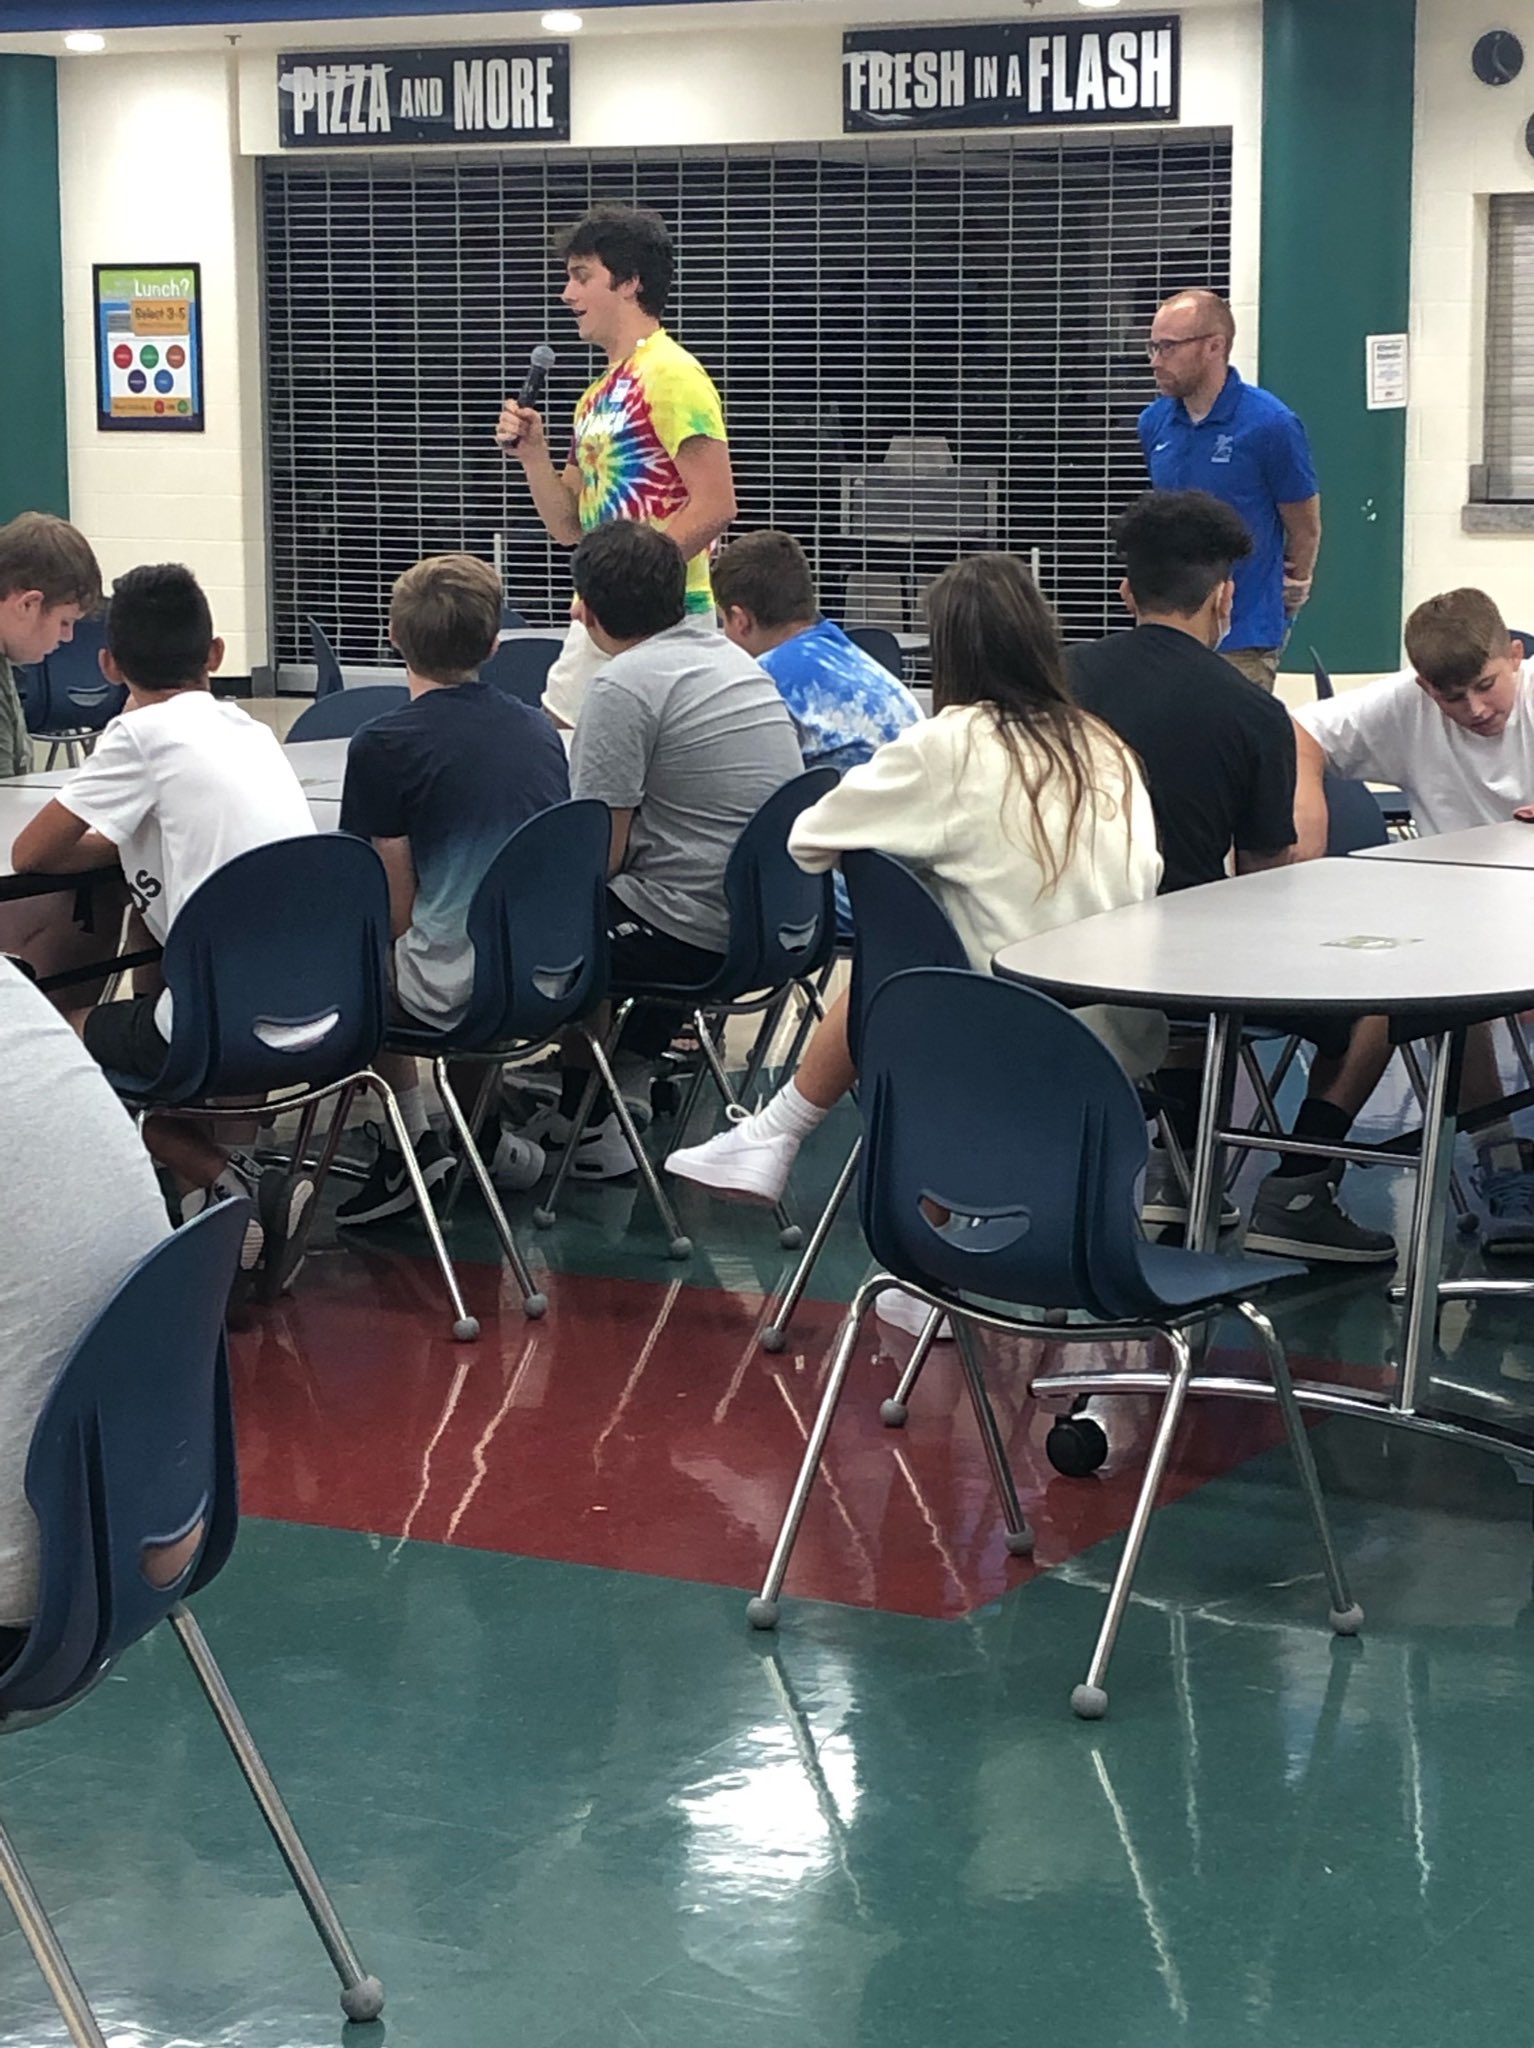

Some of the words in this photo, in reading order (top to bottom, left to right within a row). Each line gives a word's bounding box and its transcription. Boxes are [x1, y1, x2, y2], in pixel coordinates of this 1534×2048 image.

[293, 64, 391, 134] PIZZA
[401, 78, 443, 118] AND
[453, 57, 554, 131] MORE
[850, 50, 965, 110] FRESH
[974, 56, 998, 98] IN
[1006, 54, 1022, 97] A
[1028, 29, 1172, 113] FLASH
[134, 278, 190, 297] Lunch?
